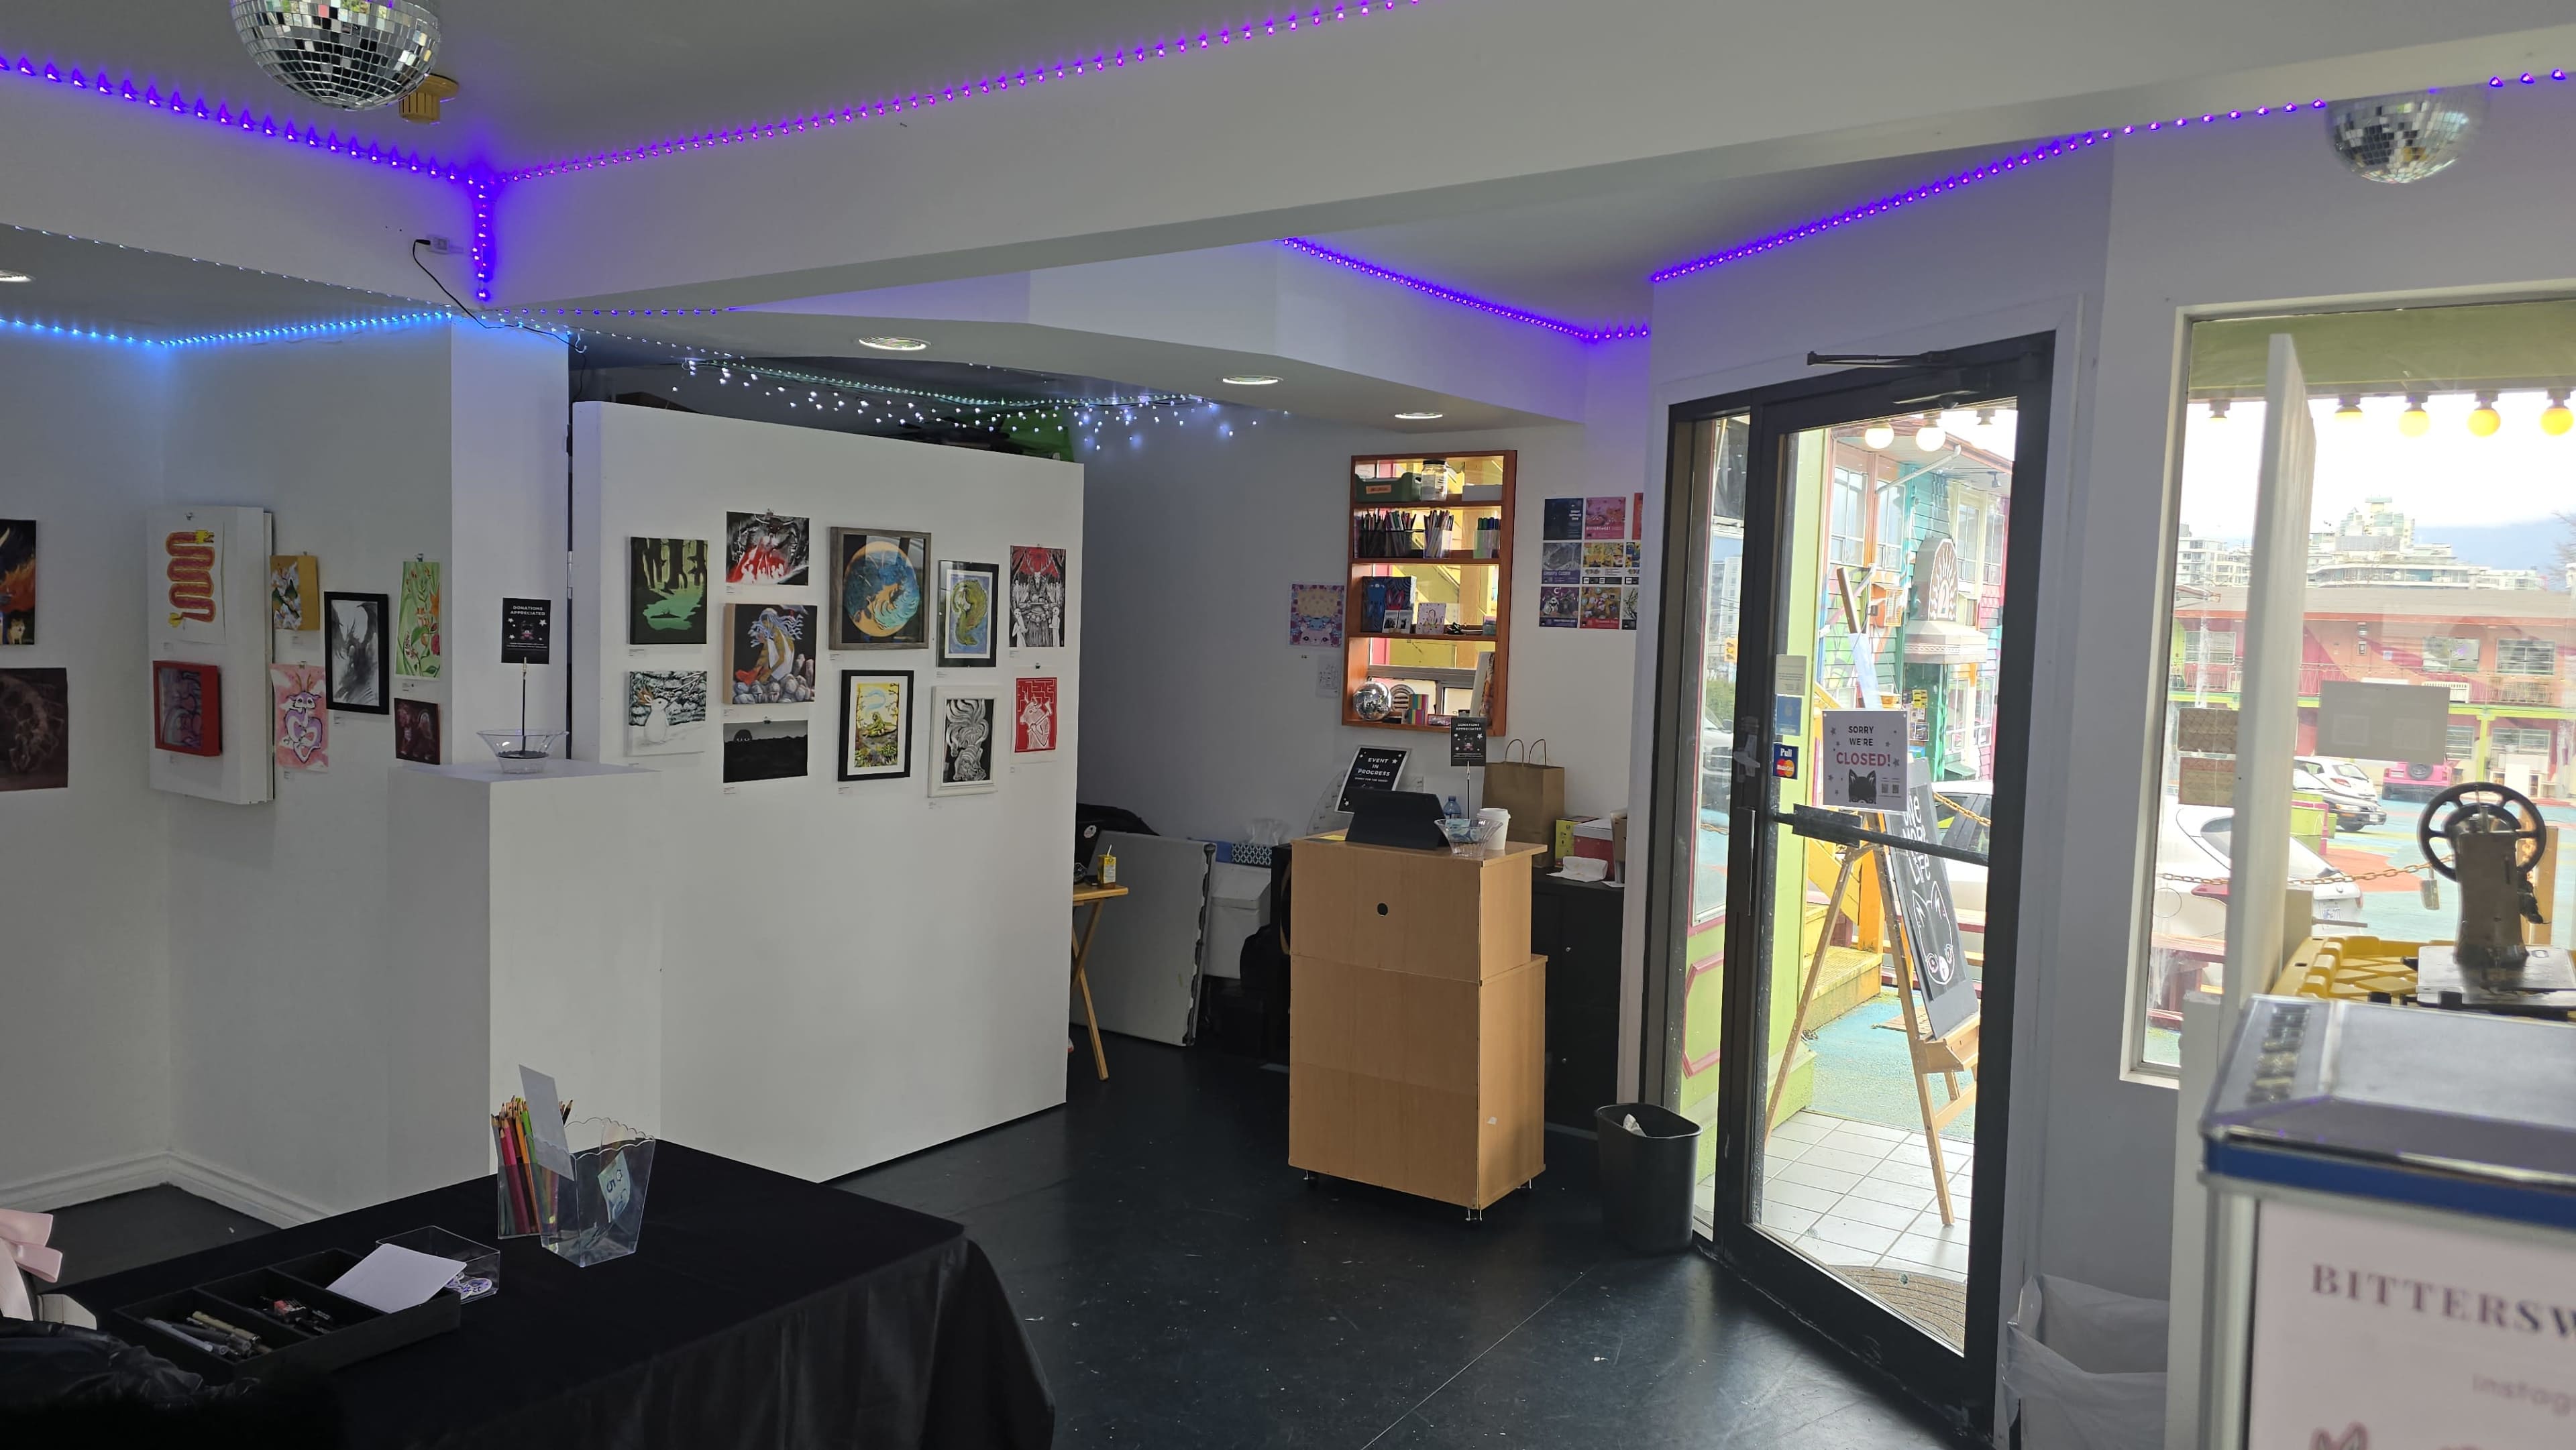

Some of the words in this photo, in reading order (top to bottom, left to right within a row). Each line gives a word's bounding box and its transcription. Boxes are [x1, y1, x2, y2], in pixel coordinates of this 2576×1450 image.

[1848, 726, 1874, 734] SORRY
[1849, 738, 1873, 746] WE'RE
[1780, 748, 1792, 757] Pull
[1836, 752, 1890, 767] CLOSED!
[1358, 769, 1391, 777] PROGRESS
[606, 1179, 616, 1193] 5
